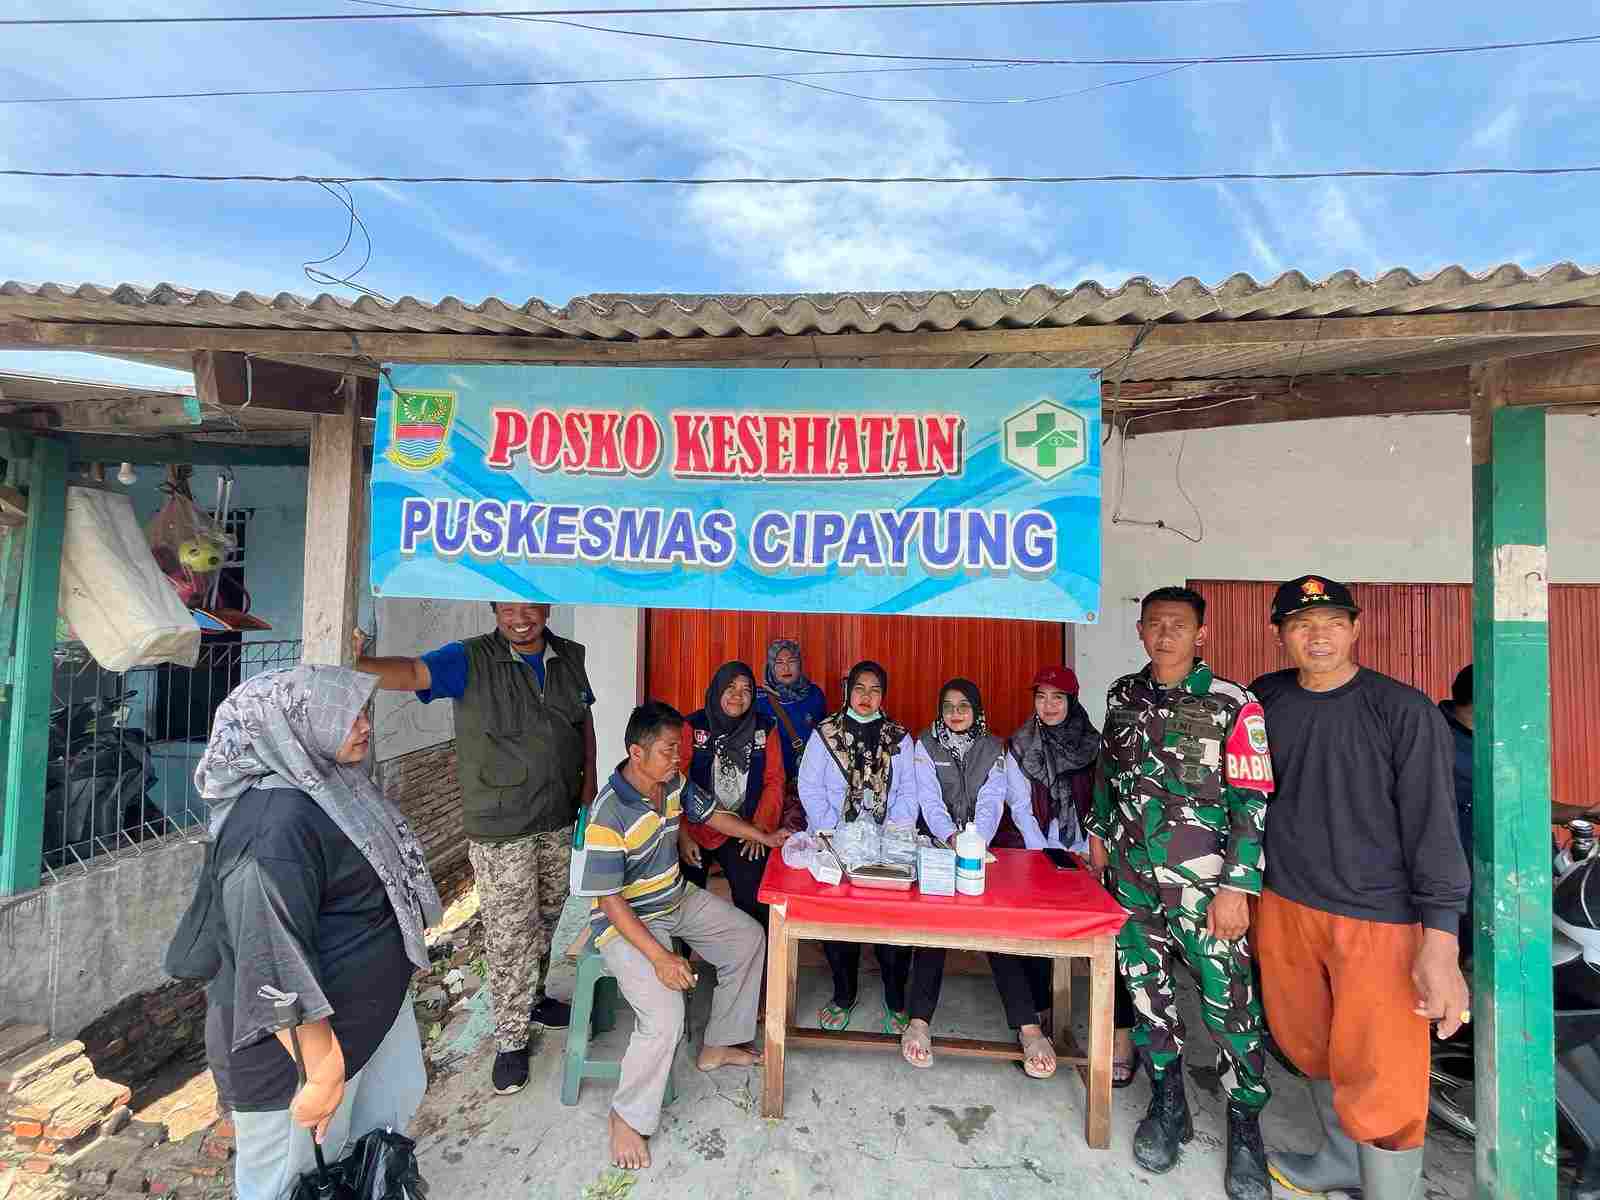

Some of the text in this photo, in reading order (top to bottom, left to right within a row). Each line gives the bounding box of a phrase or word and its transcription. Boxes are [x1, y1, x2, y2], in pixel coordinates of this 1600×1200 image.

[488, 409, 963, 479] POSKO KESEHATAN
[401, 498, 1057, 573] PUSKESMAS CIPAYUNG
